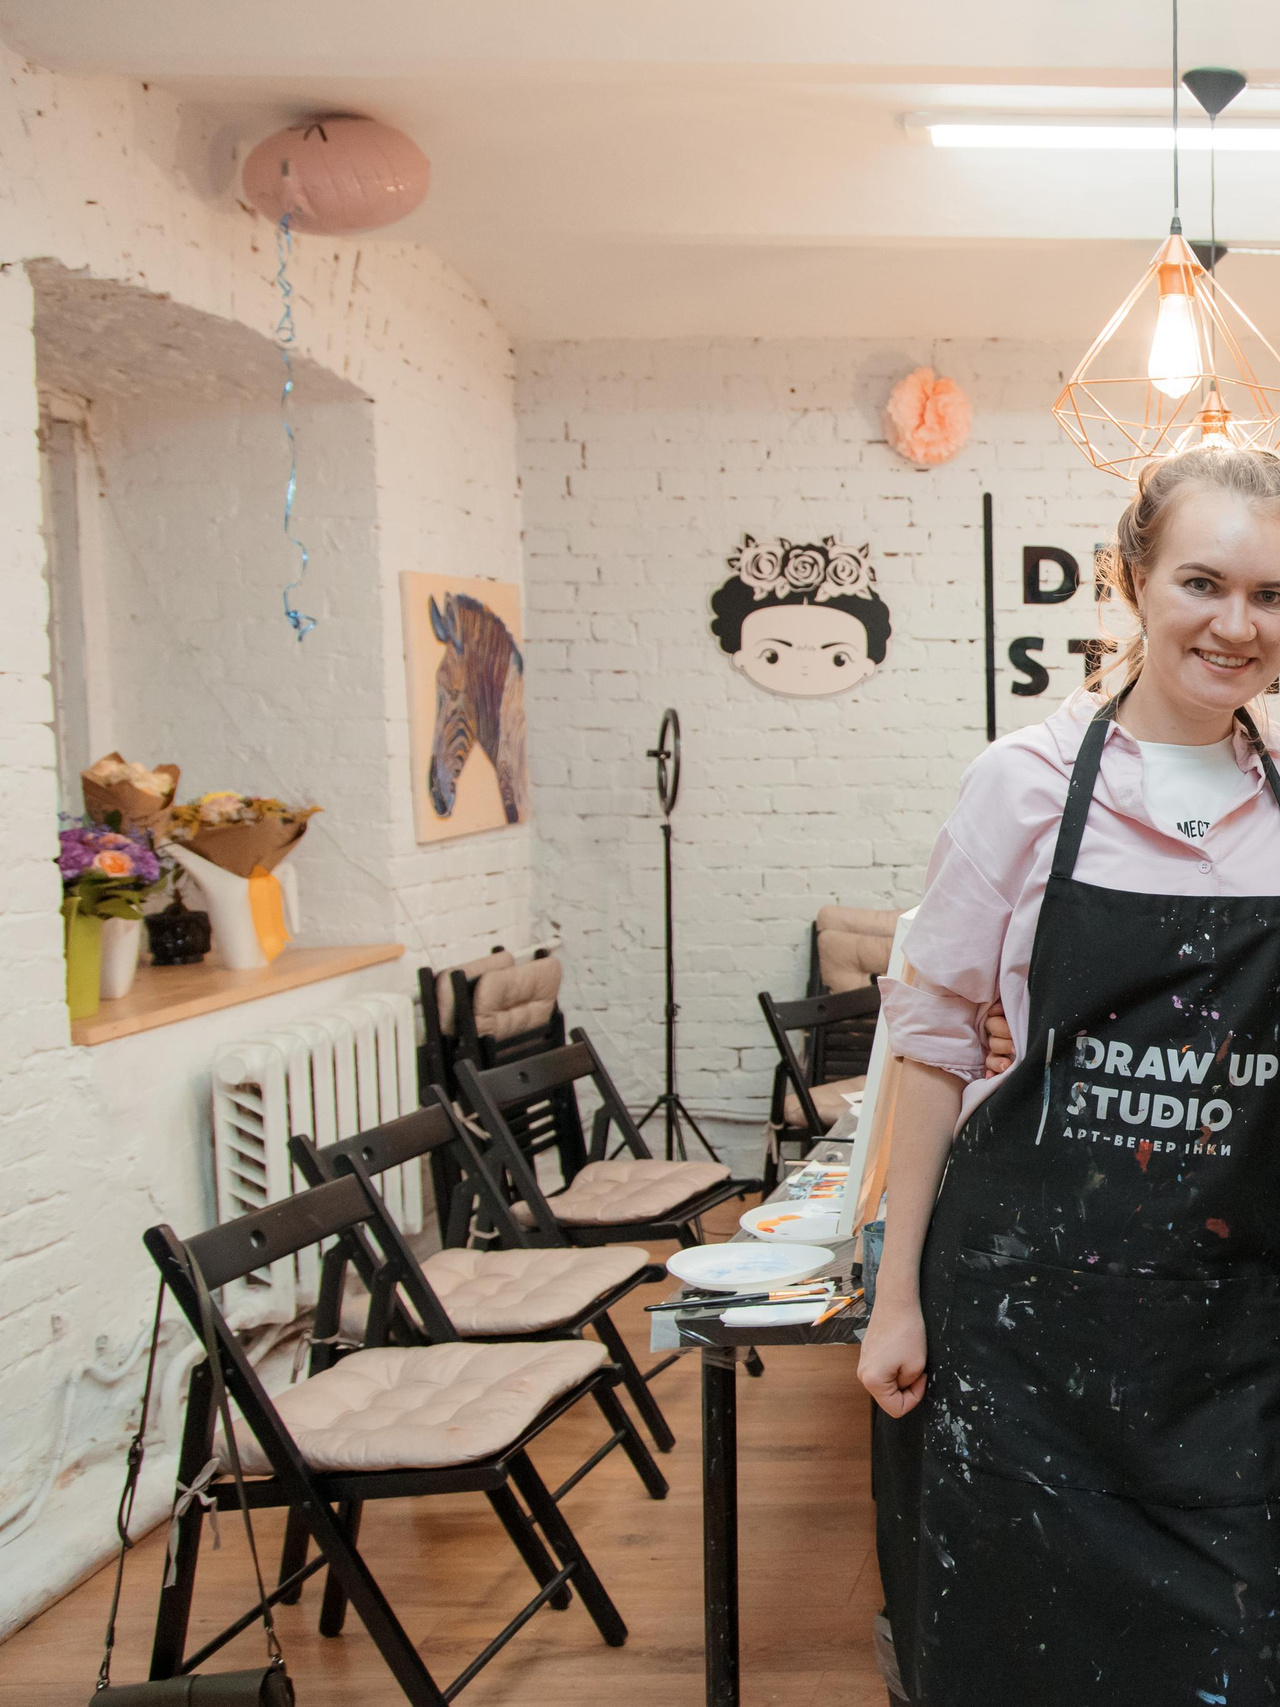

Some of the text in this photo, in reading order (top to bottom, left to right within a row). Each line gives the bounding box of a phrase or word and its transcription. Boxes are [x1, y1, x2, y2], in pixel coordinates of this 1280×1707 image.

[1074, 1036, 1280, 1088] DRAW UP
[1066, 1081, 1233, 1132] STUDIO
